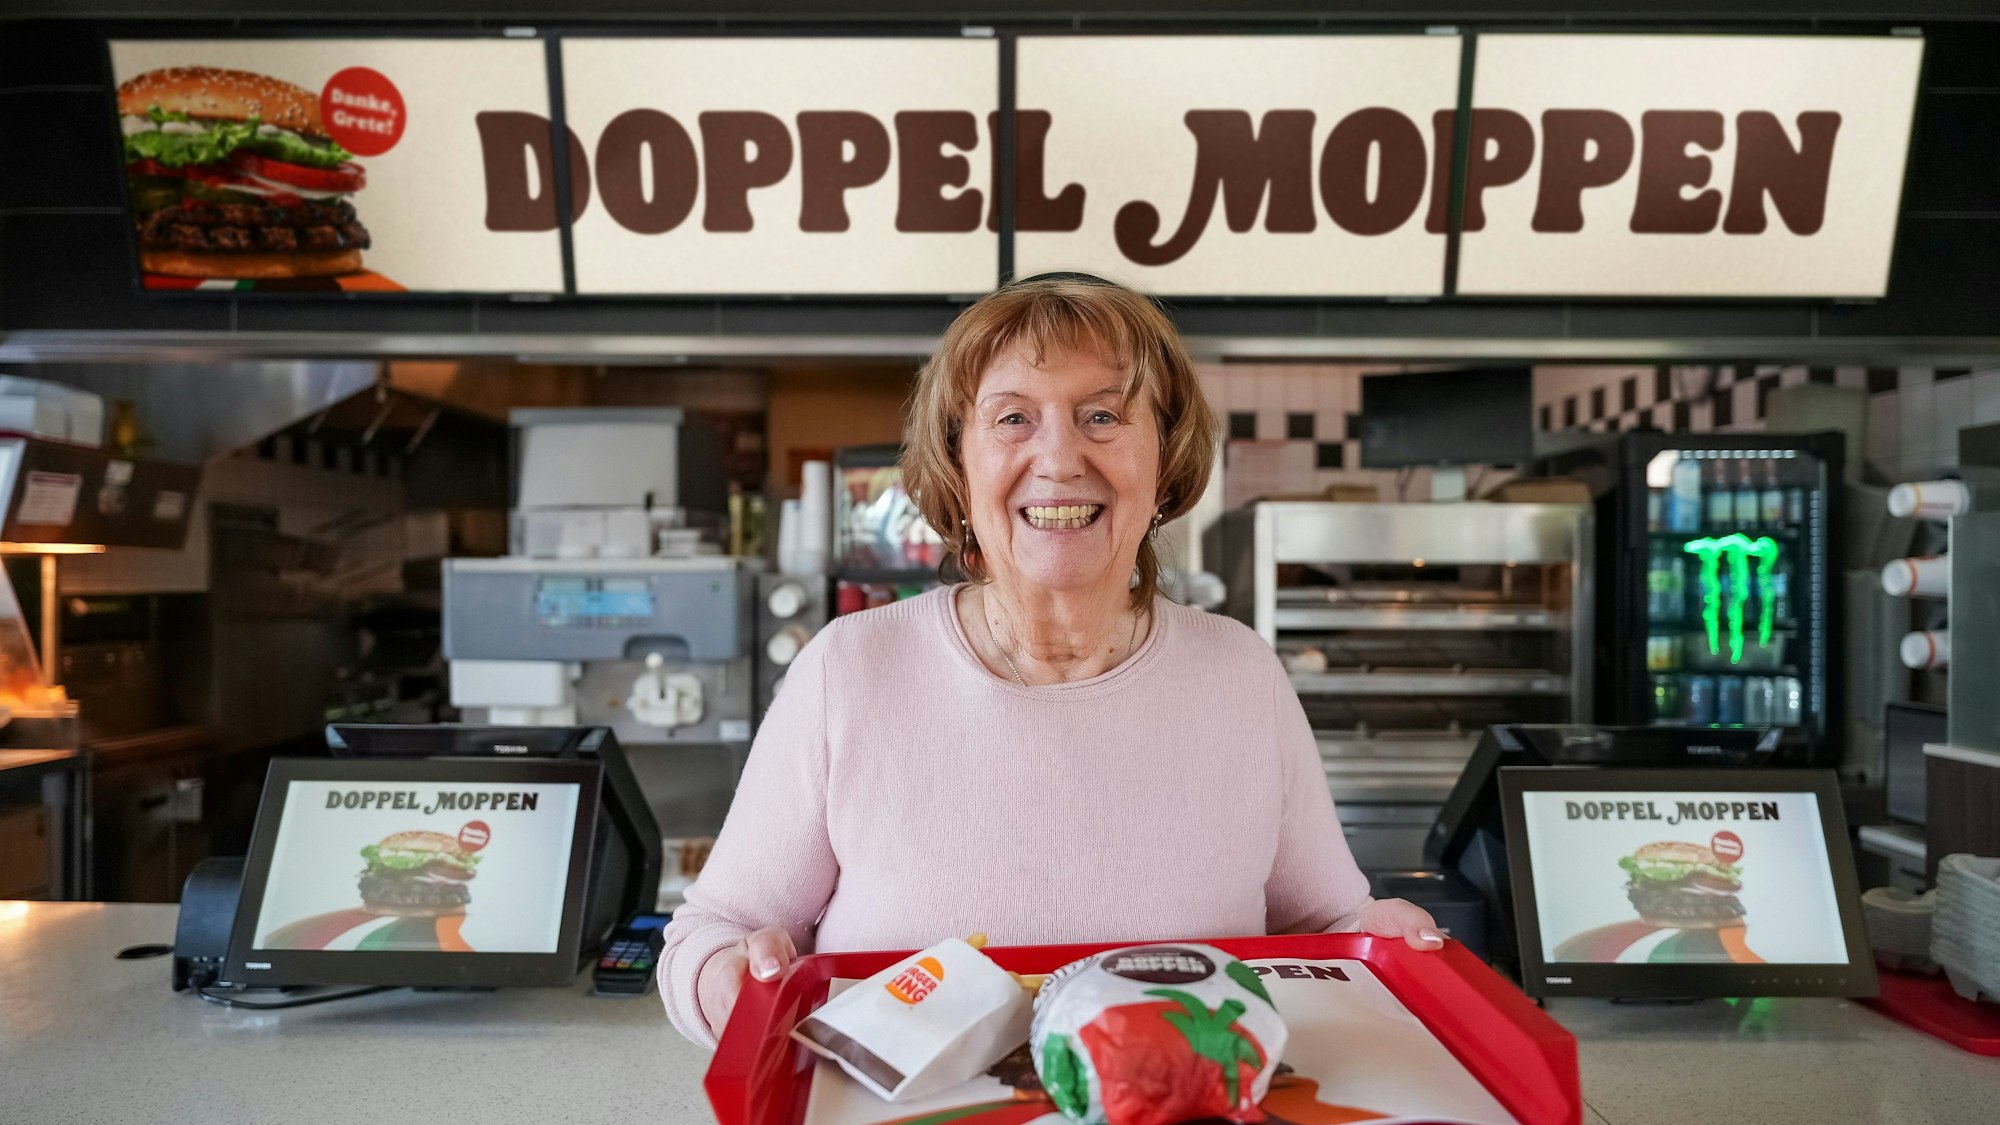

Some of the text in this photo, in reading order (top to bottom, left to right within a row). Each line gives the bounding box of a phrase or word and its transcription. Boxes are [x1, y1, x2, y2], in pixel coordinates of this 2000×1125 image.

[331, 88, 397, 118] Danke,
[333, 109, 394, 135] Grete!
[475, 106, 1842, 267] DOPPEL MOPPEN
[325, 791, 539, 815] DOPPEL MOPPEN
[1565, 801, 1780, 825] DOPPEL MOPPEN
[1249, 964, 1351, 982] PEN
[891, 974, 928, 1002] ING
